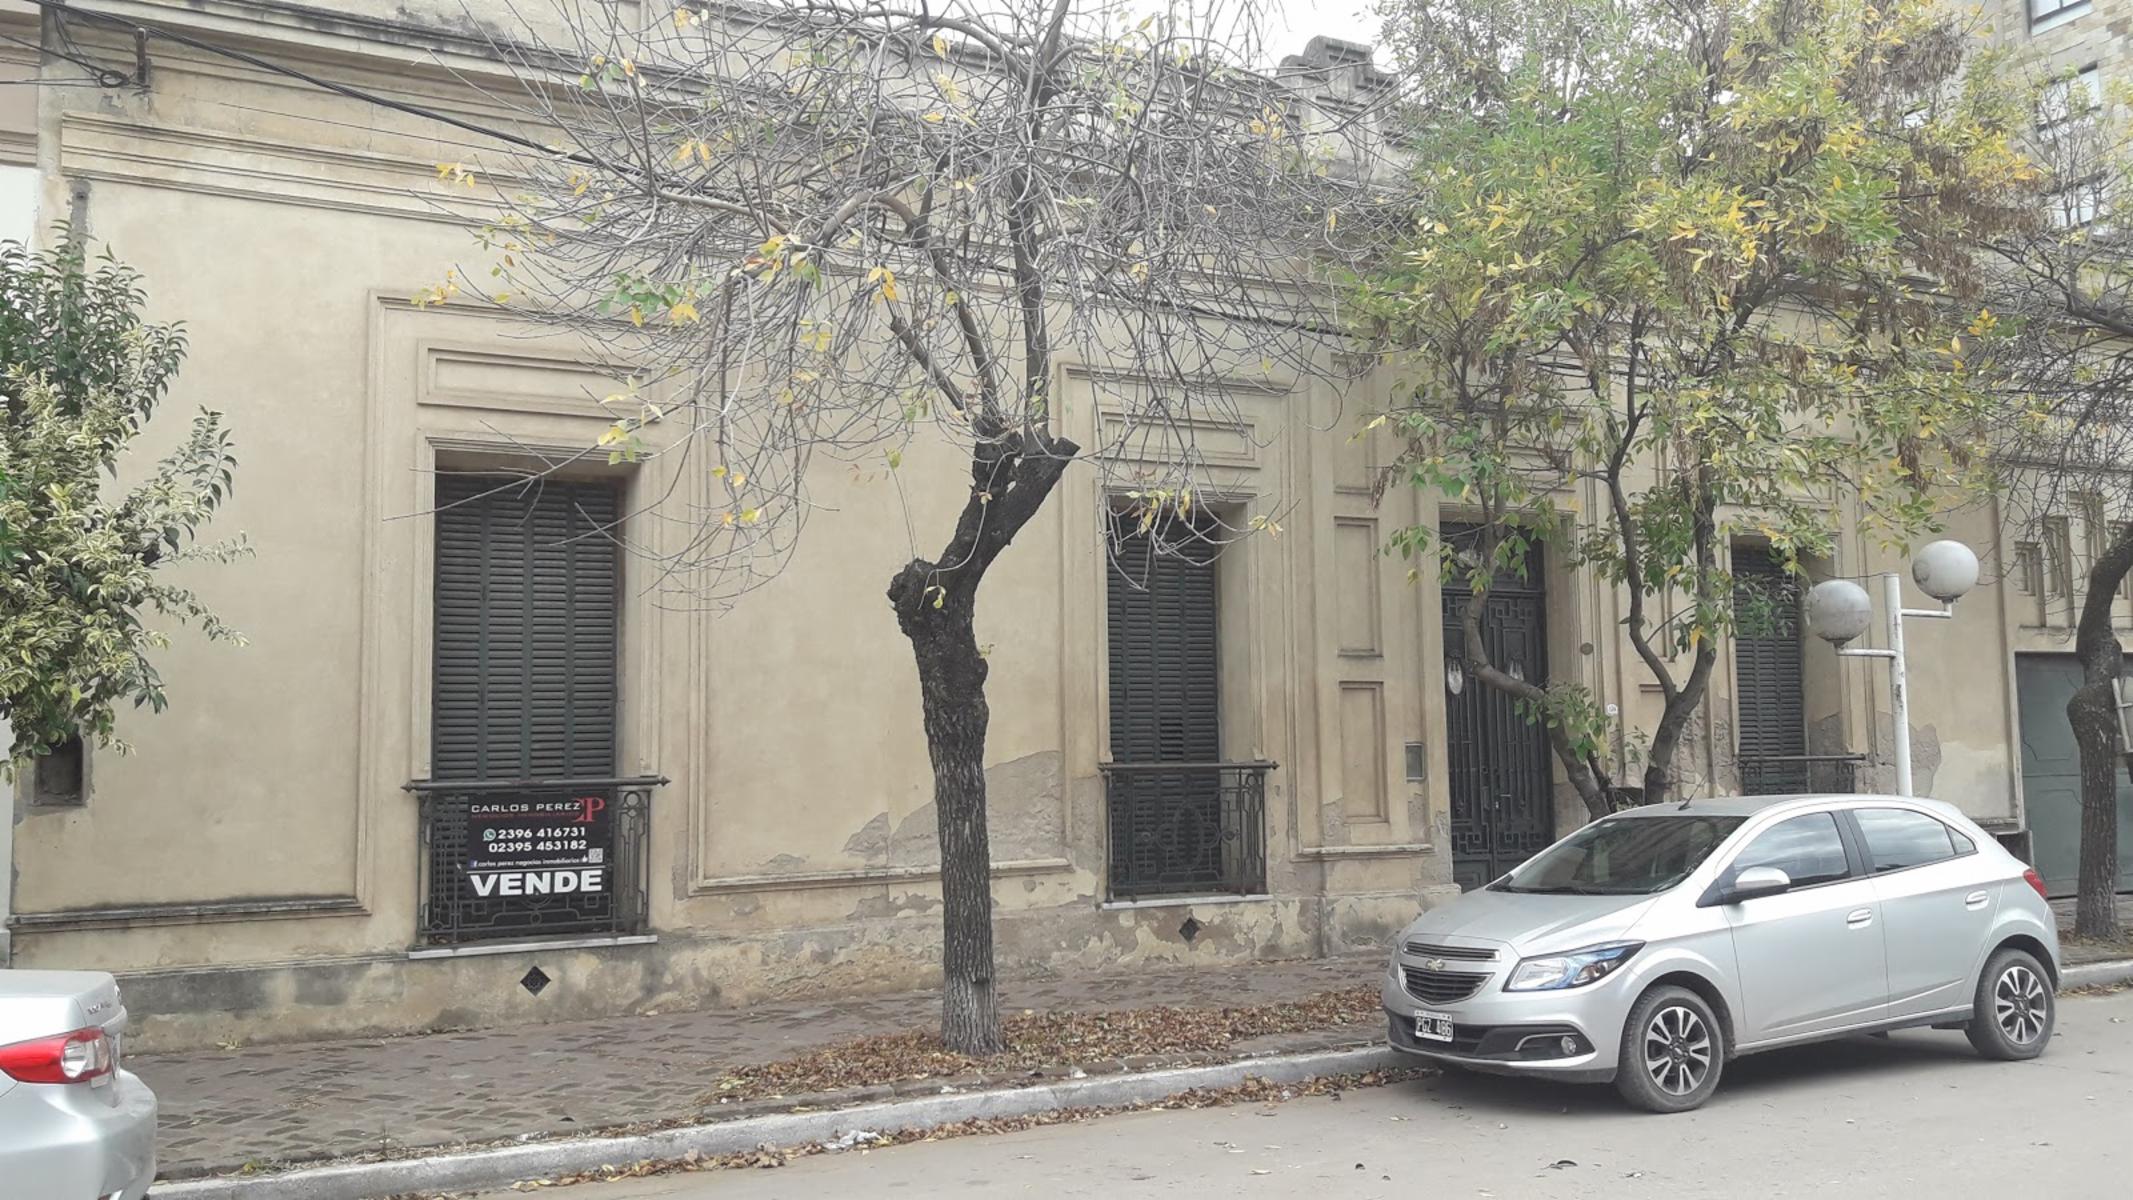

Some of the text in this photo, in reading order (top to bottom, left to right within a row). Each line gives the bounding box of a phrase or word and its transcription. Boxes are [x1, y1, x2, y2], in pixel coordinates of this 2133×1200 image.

[471, 802, 581, 813] CARLOS PEREZ
[498, 827, 585, 839] 2396 416731
[488, 840, 587, 852] 02395 453182
[470, 870, 602, 897] VENDE
